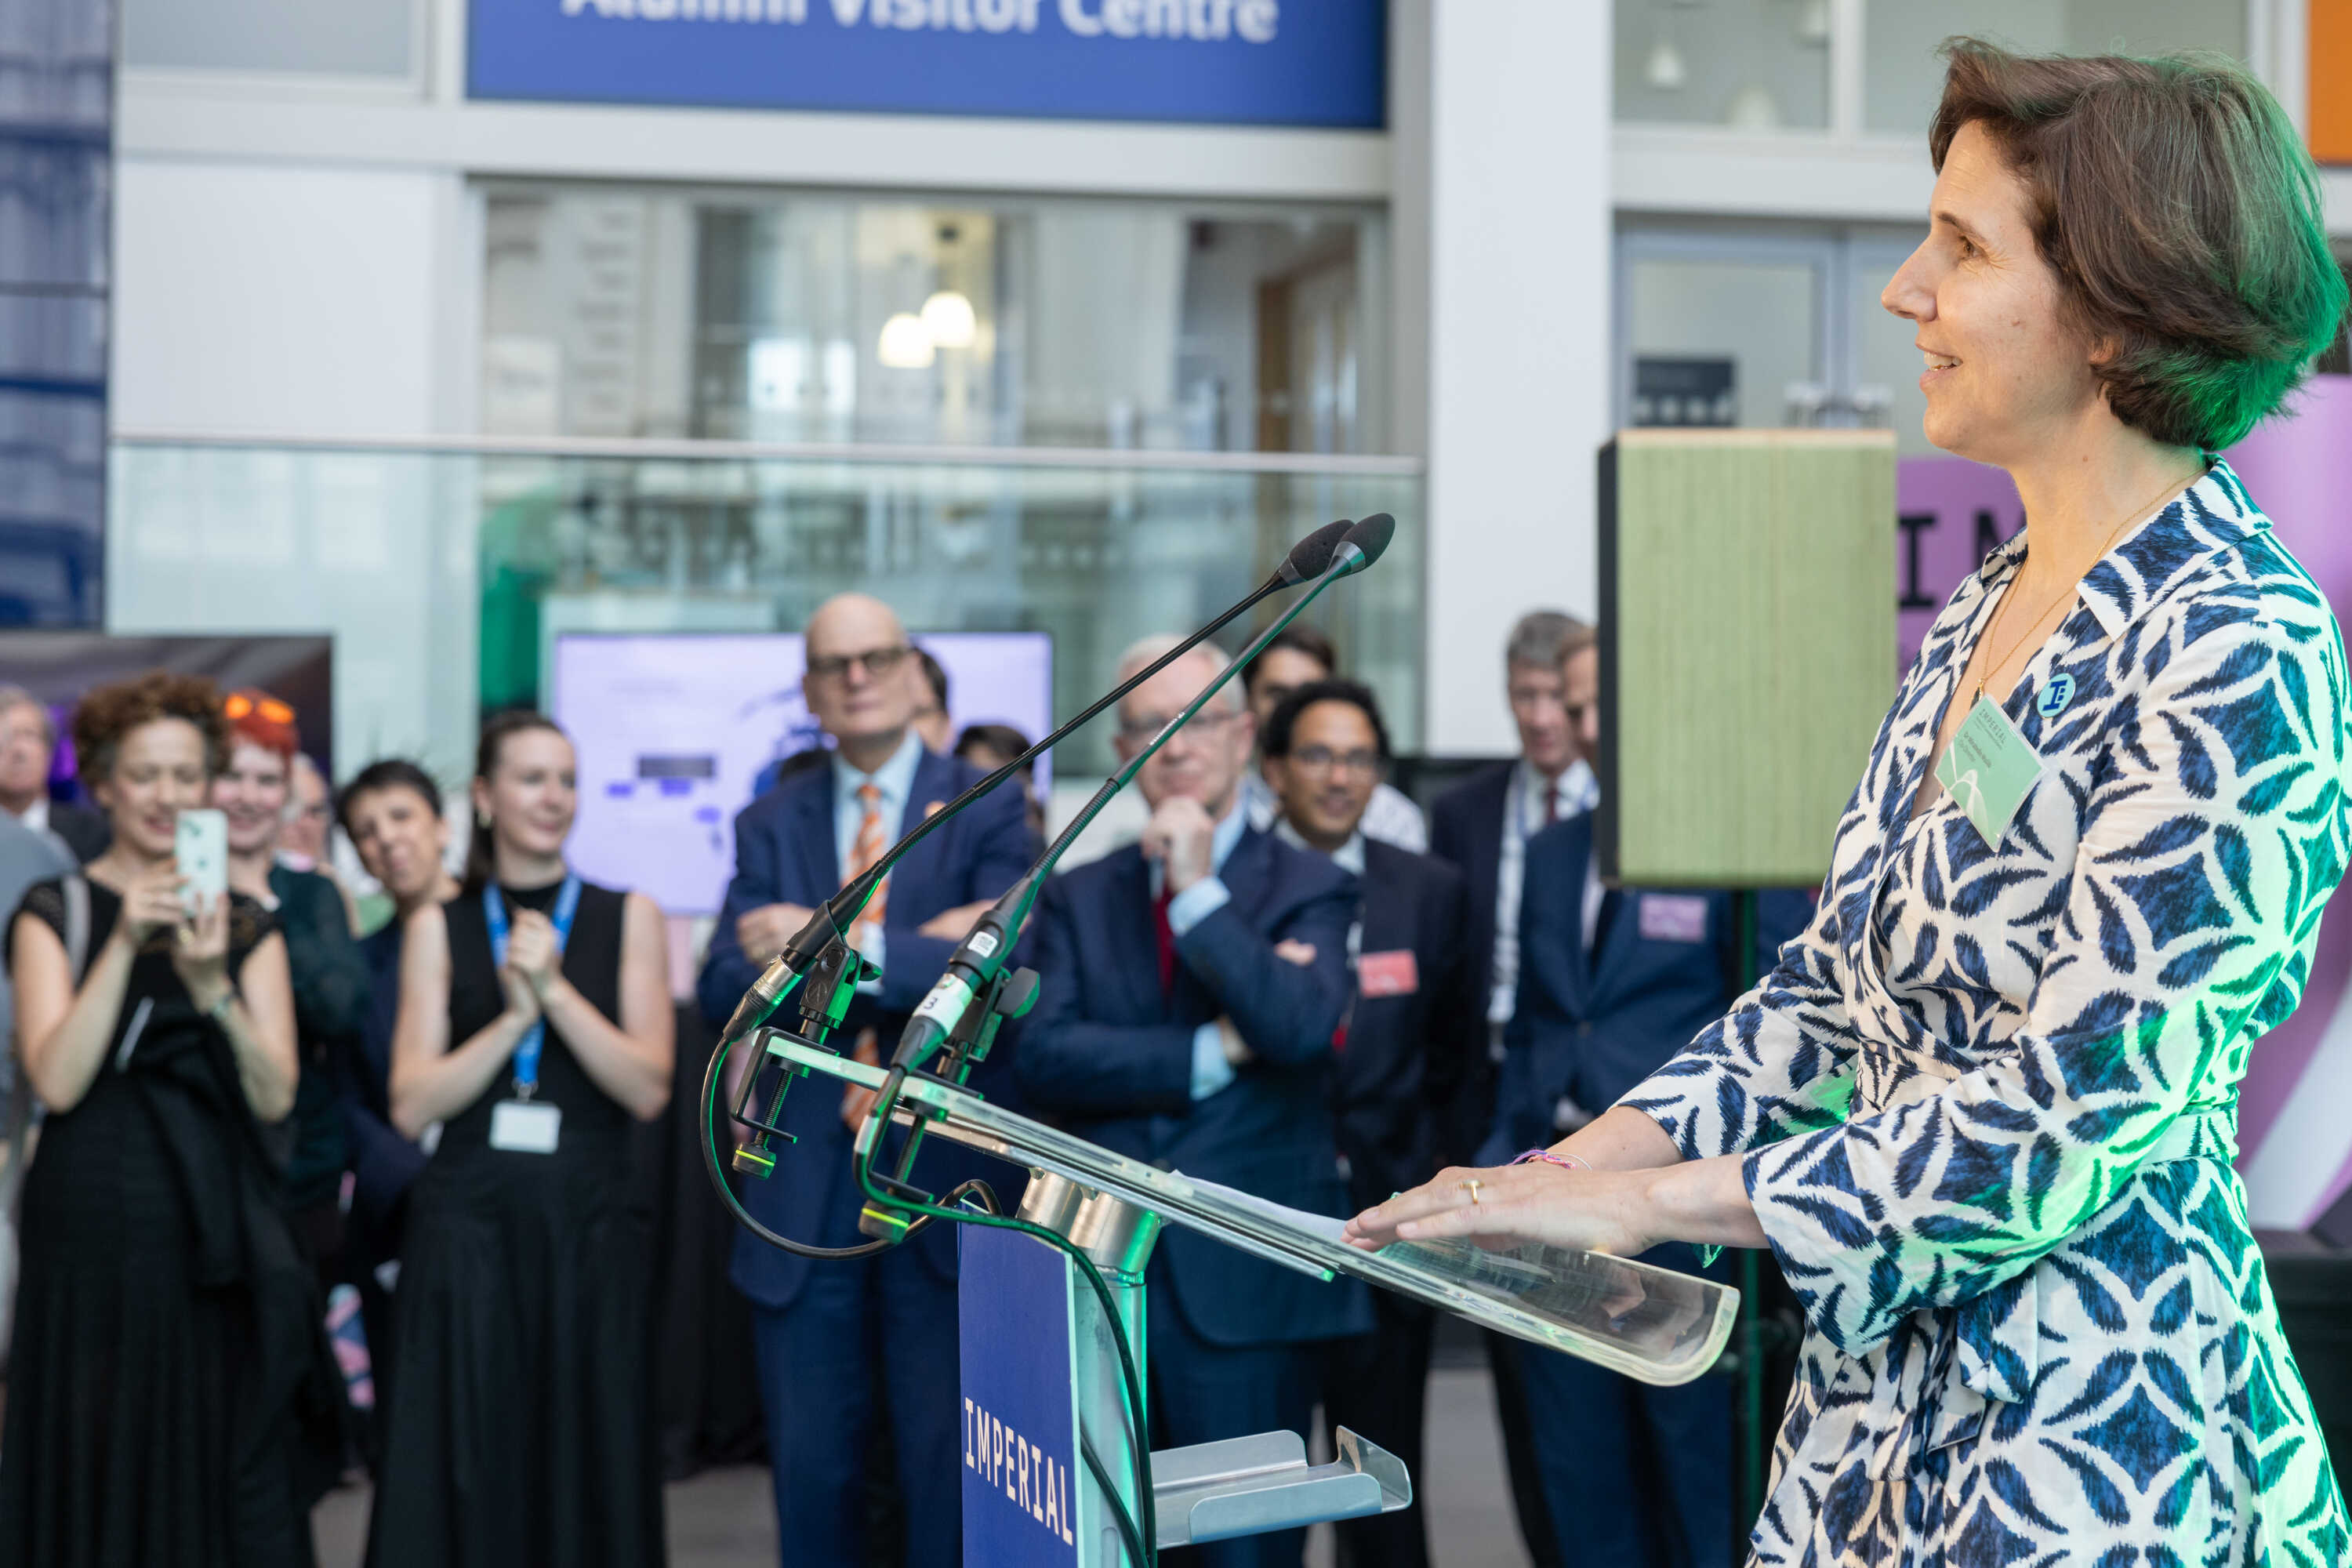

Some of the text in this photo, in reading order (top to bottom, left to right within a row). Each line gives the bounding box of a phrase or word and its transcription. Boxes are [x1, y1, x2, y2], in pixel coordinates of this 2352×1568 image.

[1058, 0, 1276, 42] Centre
[1979, 708, 2006, 744] IMPERIAL
[924, 996, 938, 1010] 3
[965, 1396, 1073, 1546] IMPERIAL
